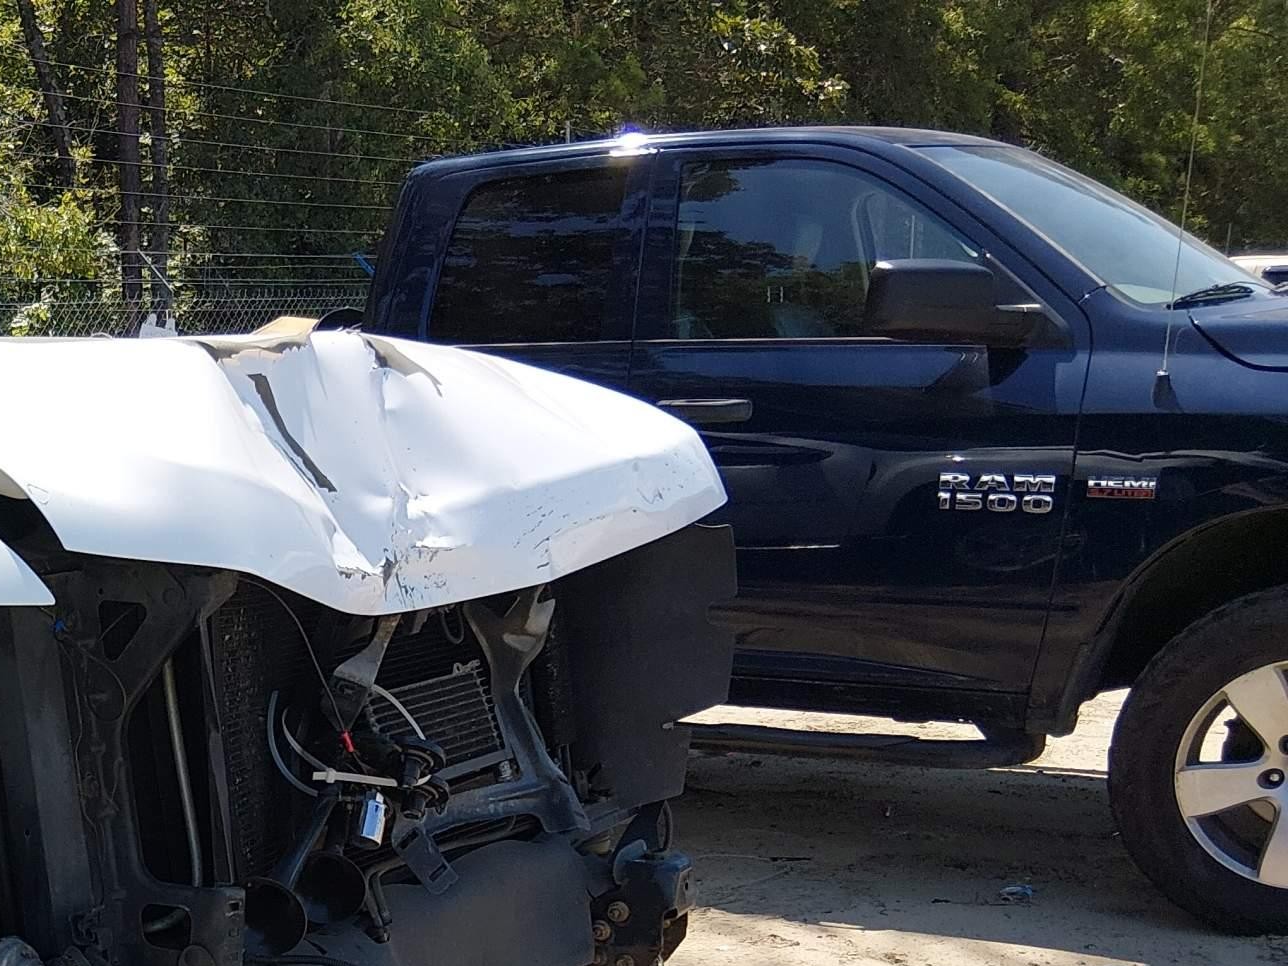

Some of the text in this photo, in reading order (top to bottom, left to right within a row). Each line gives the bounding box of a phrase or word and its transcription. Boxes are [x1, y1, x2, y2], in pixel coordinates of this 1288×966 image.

[938, 472, 1056, 493] RAM
[1087, 476, 1157, 488] HEMI
[937, 492, 1053, 514] 1500
